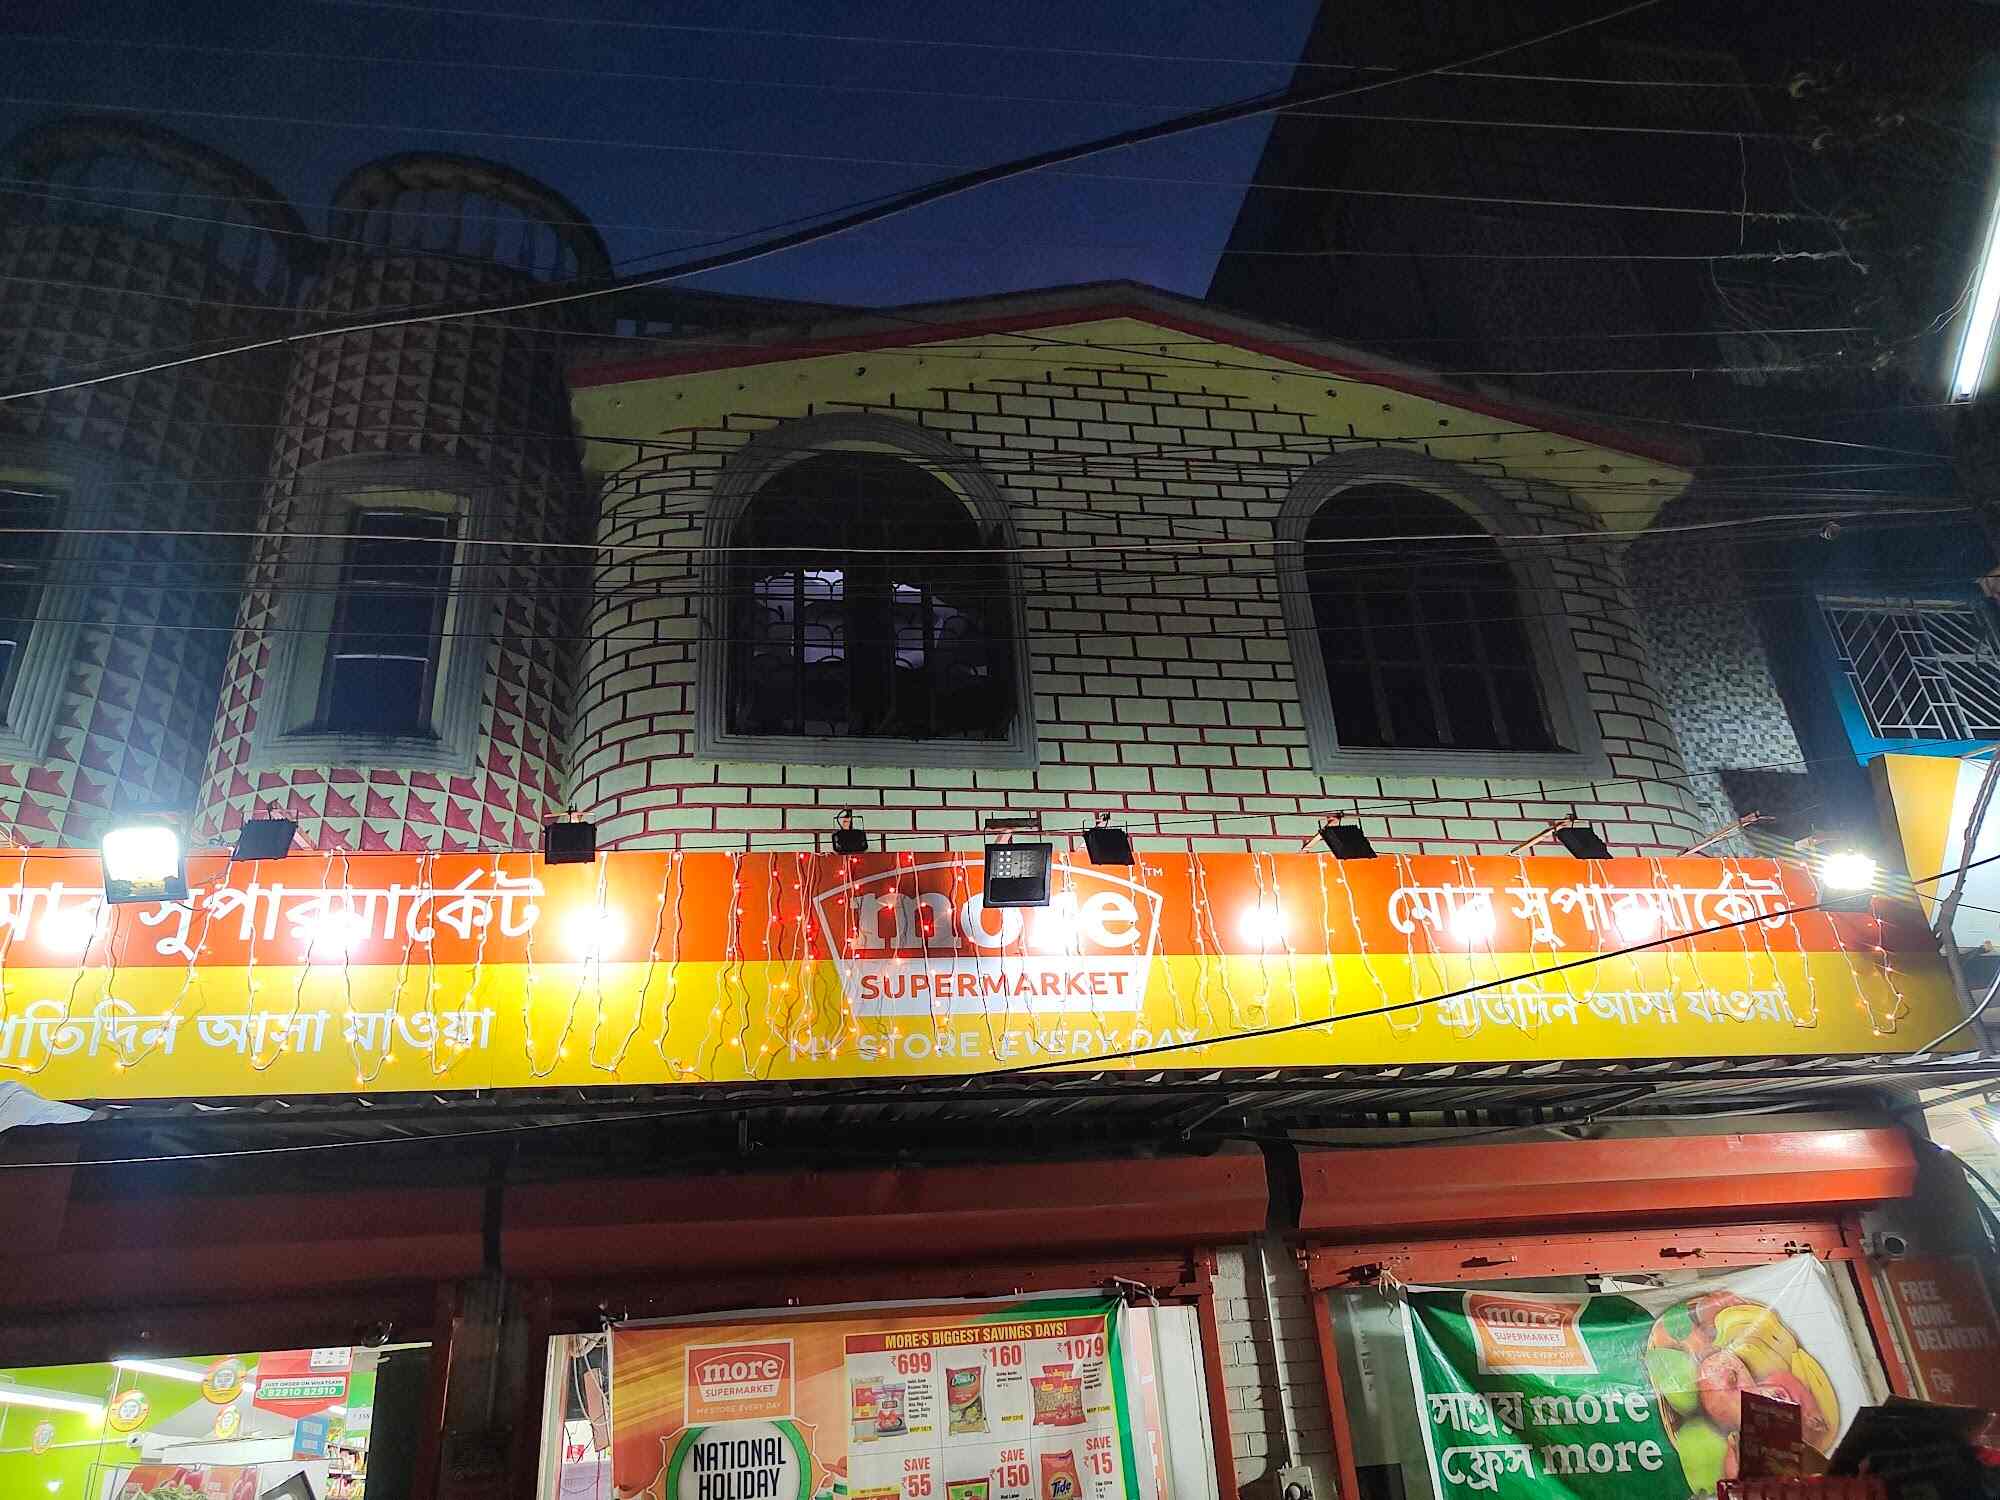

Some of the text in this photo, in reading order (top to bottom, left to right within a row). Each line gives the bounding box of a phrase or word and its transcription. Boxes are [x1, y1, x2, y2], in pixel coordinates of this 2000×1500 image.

[861, 971, 1129, 1000] SUPERMARKET
[1587, 988, 1679, 1024] আসা
[197, 1008, 331, 1054] আসা
[789, 1027, 1201, 1063] MY STORE EVERY DAY
[1483, 1306, 1561, 1328] more
[885, 1321, 1067, 1350] MORE'S BIGGEST SAVINGS DAYS!
[1494, 1331, 1561, 1343] SUPERMARKET
[703, 1359, 778, 1383] more
[705, 1384, 774, 1398] SUPERMARKET
[1530, 1391, 1651, 1425] more
[693, 1437, 787, 1473] NATIONAL
[1000, 1448, 1025, 1463] SAVE
[1086, 1436, 1112, 1451] SAVE
[1541, 1439, 1664, 1475] more
[903, 1456, 931, 1472] SAVE
[699, 1468, 780, 1500] HOLIDAY
[1051, 1478, 1072, 1498] Tide
